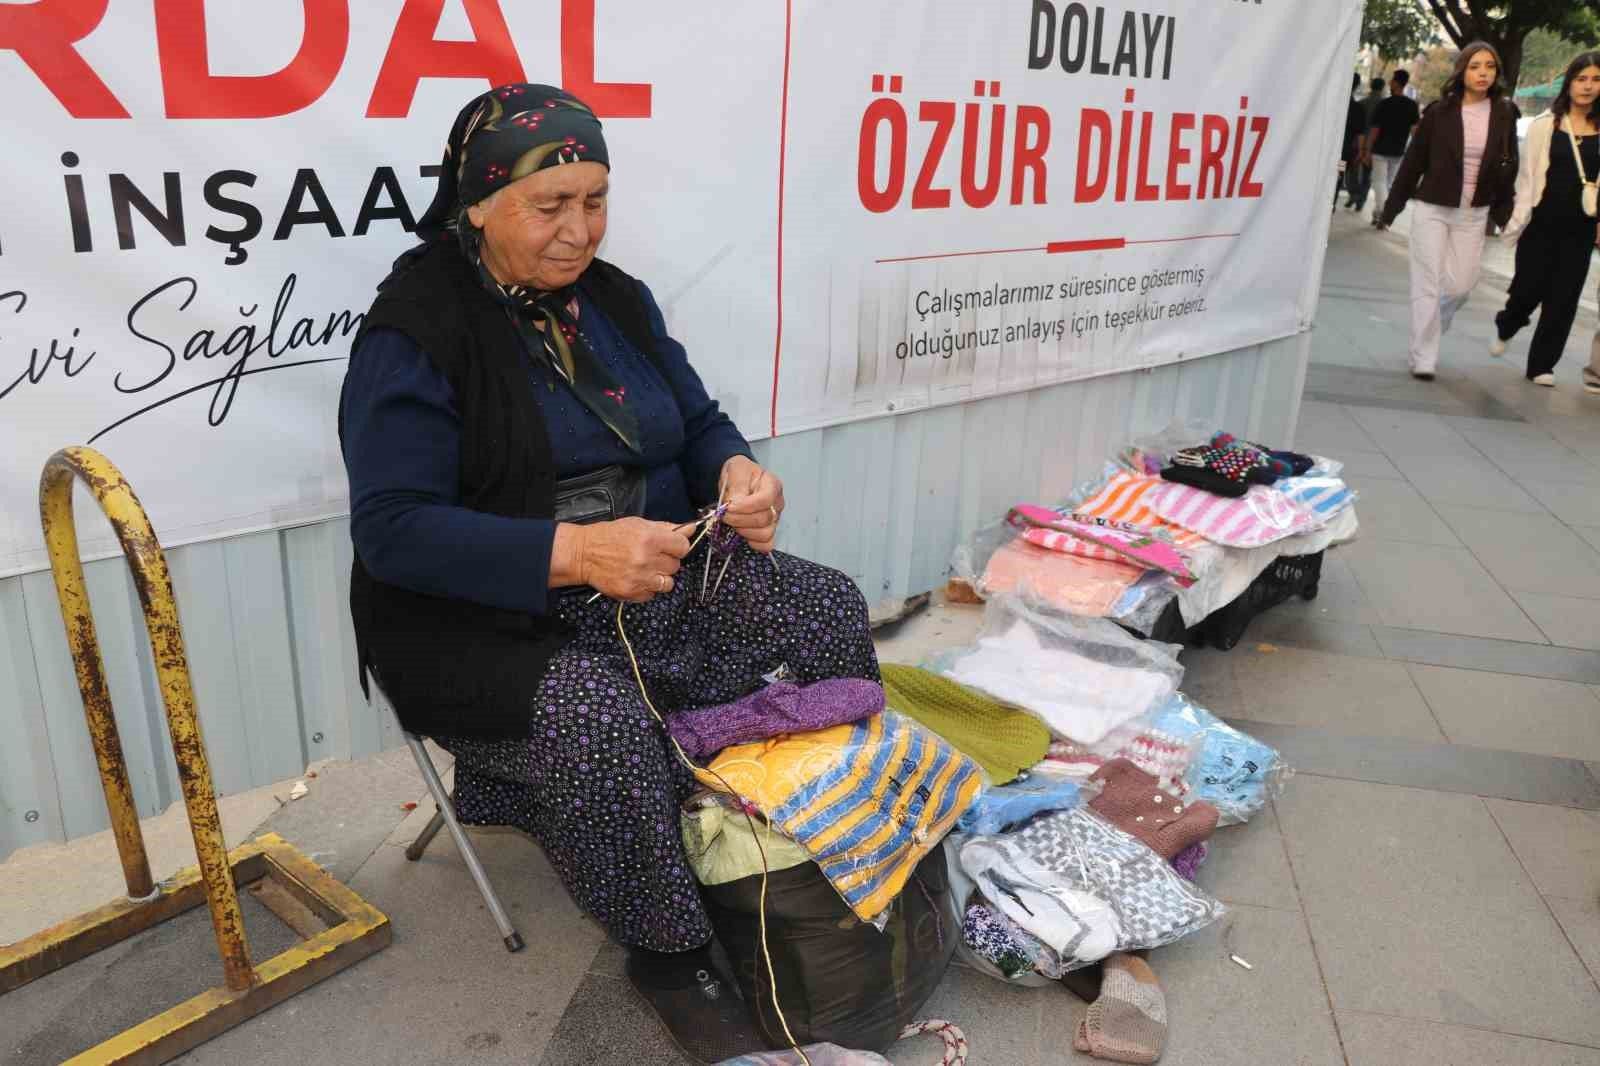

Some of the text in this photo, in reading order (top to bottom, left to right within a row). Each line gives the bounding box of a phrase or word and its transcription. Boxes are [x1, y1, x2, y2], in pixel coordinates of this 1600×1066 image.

[1028, 0, 1176, 80] DOLAYI
[857, 74, 1271, 214] ÖZÜR DİLERİZ
[915, 264, 1205, 322] Çalışmalarımız süresince göstermiş
[895, 328, 1000, 360] olduğunuz
[1005, 316, 1065, 343] anlayış
[1071, 309, 1099, 338] için
[1104, 300, 1165, 333] teşekkür
